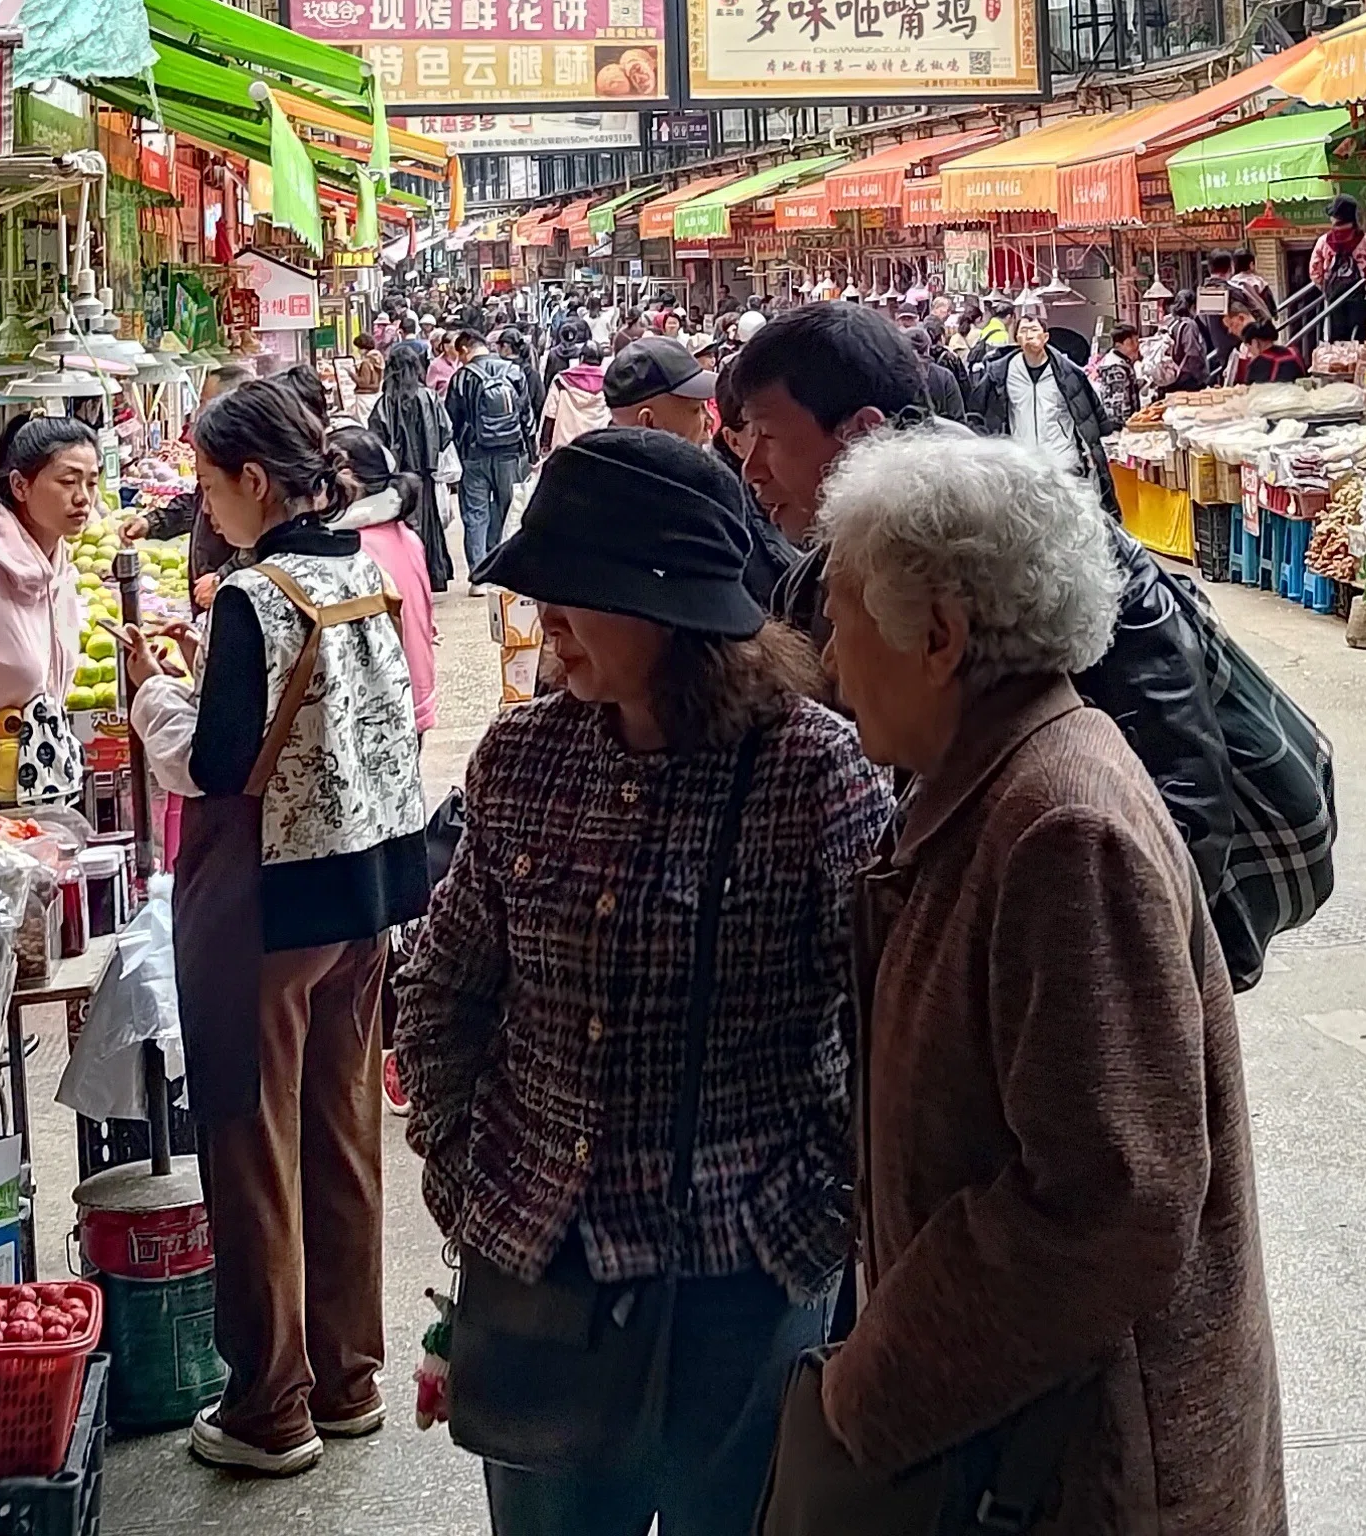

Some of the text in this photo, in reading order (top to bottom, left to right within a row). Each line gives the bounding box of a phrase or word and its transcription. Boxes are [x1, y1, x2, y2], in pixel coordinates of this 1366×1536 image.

[369, 44, 589, 87] 特色云腿酥
[421, 114, 498, 134] 优惠多多
